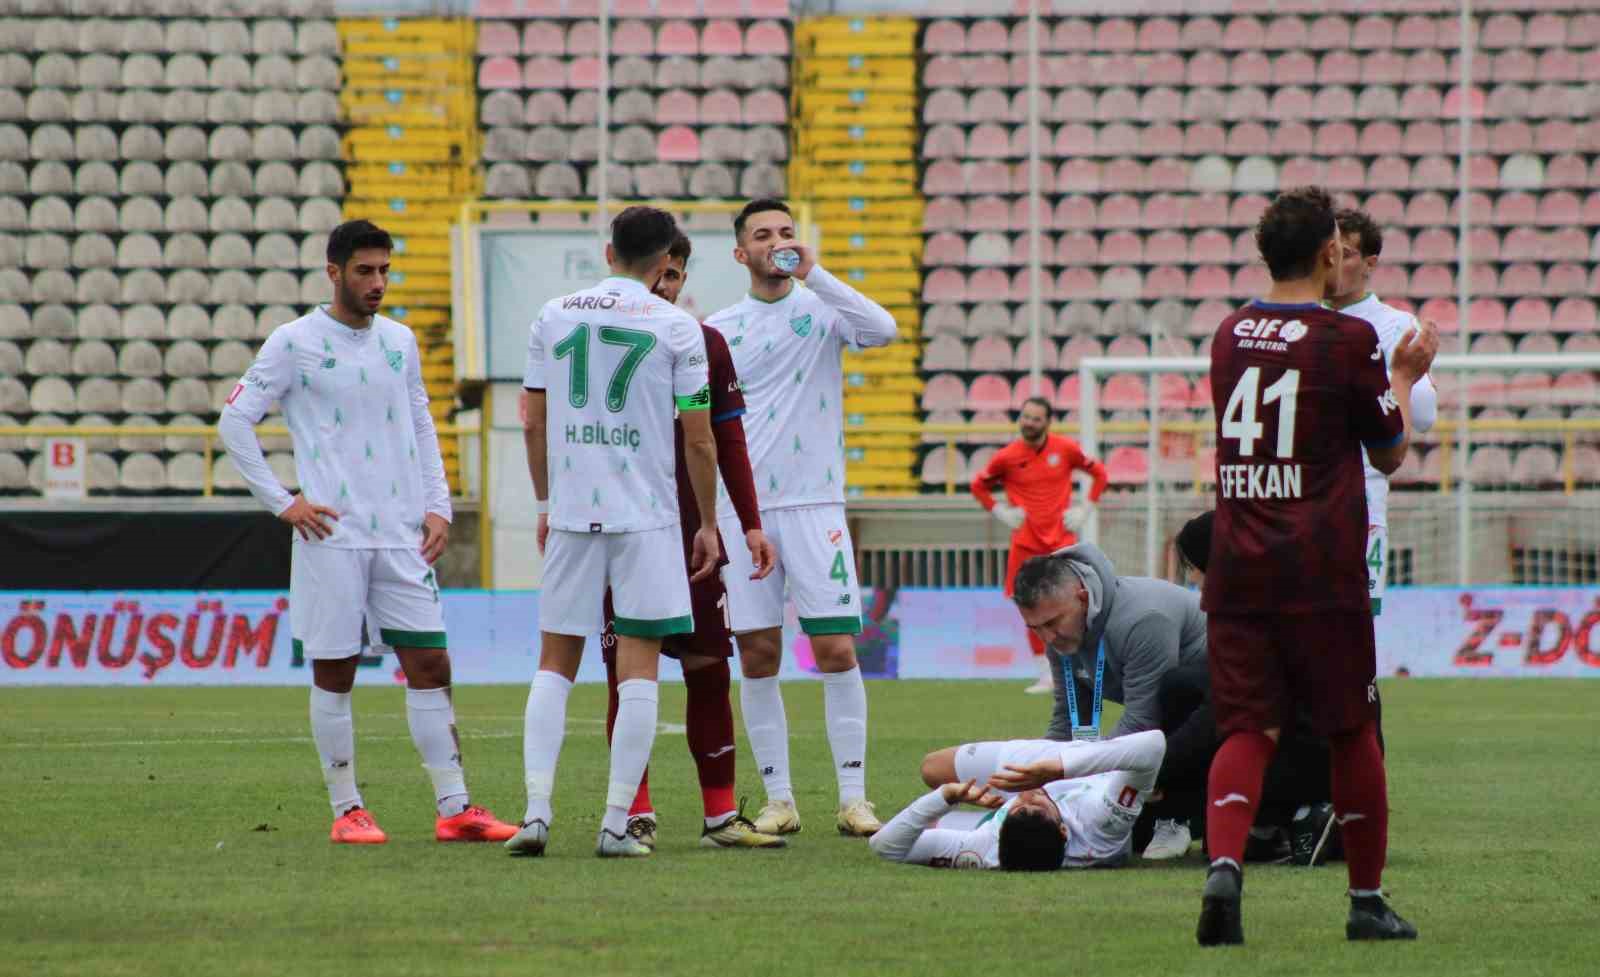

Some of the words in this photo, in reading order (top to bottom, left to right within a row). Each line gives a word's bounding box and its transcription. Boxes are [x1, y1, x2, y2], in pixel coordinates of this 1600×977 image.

[1254, 340, 1288, 351] PETROL
[552, 322, 656, 412] 17
[1221, 366, 1300, 458] 41
[52, 442, 76, 467] B
[565, 421, 641, 452] H.BİLGİÇ
[830, 549, 849, 587] 4
[0, 599, 280, 679] ÖNÜŞÜM
